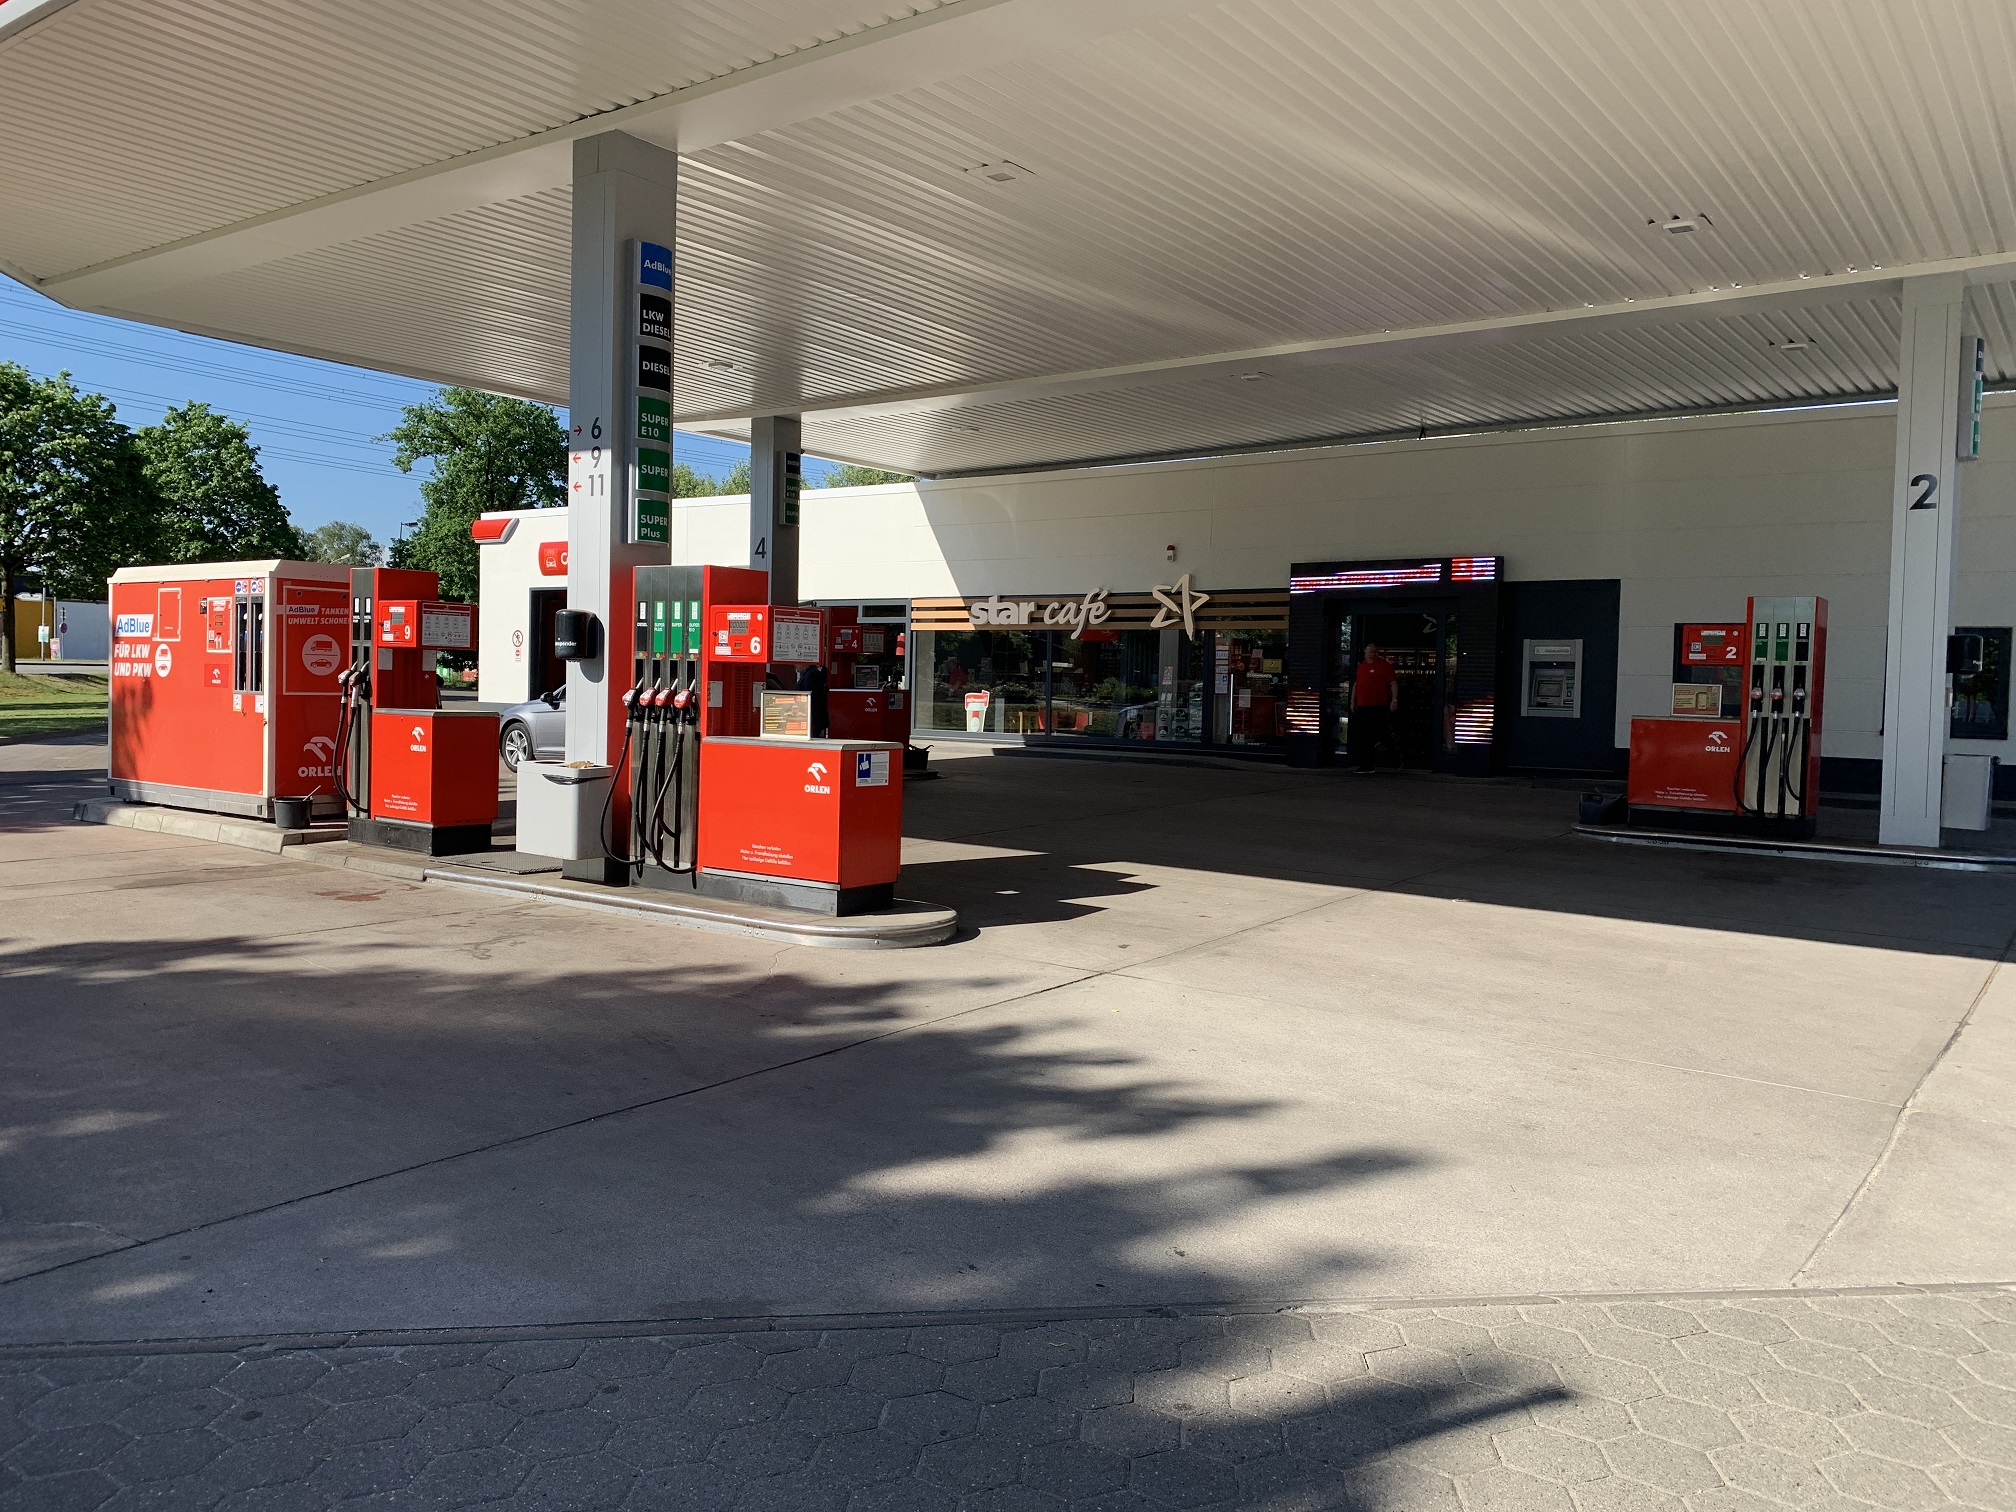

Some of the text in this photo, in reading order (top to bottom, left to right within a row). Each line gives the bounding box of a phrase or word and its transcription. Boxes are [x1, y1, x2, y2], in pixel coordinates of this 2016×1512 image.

[644, 260, 672, 276] AdBlue
[642, 309, 664, 322] LKW
[642, 322, 670, 338] DIESEL
[642, 360, 670, 376] DIESEL
[641, 412, 668, 427] SUPER
[591, 416, 602, 440] 6
[641, 426, 659, 438] E10
[591, 446, 602, 468] 9
[641, 464, 669, 478] SUPER
[588, 473, 604, 496] 11
[1908, 473, 1938, 511] 2
[640, 514, 668, 527] SUPER
[640, 528, 660, 538] Plus
[754, 536, 766, 559] 4
[288, 606, 316, 614] AdBlue
[969, 587, 1112, 640] star café
[117, 617, 150, 634] AdBlue
[288, 617, 319, 625] UMWELT
[404, 625, 411, 640] 9
[114, 640, 150, 658] FÜR LKW
[214, 636, 222, 650] 11
[750, 636, 761, 654] 6
[852, 640, 858, 648] 4
[1726, 646, 1737, 659] 2
[114, 662, 152, 678] UND PKW
[410, 744, 426, 752] ORLEN
[1705, 745, 1730, 753] ORLEN
[804, 784, 830, 794] ORLEN
